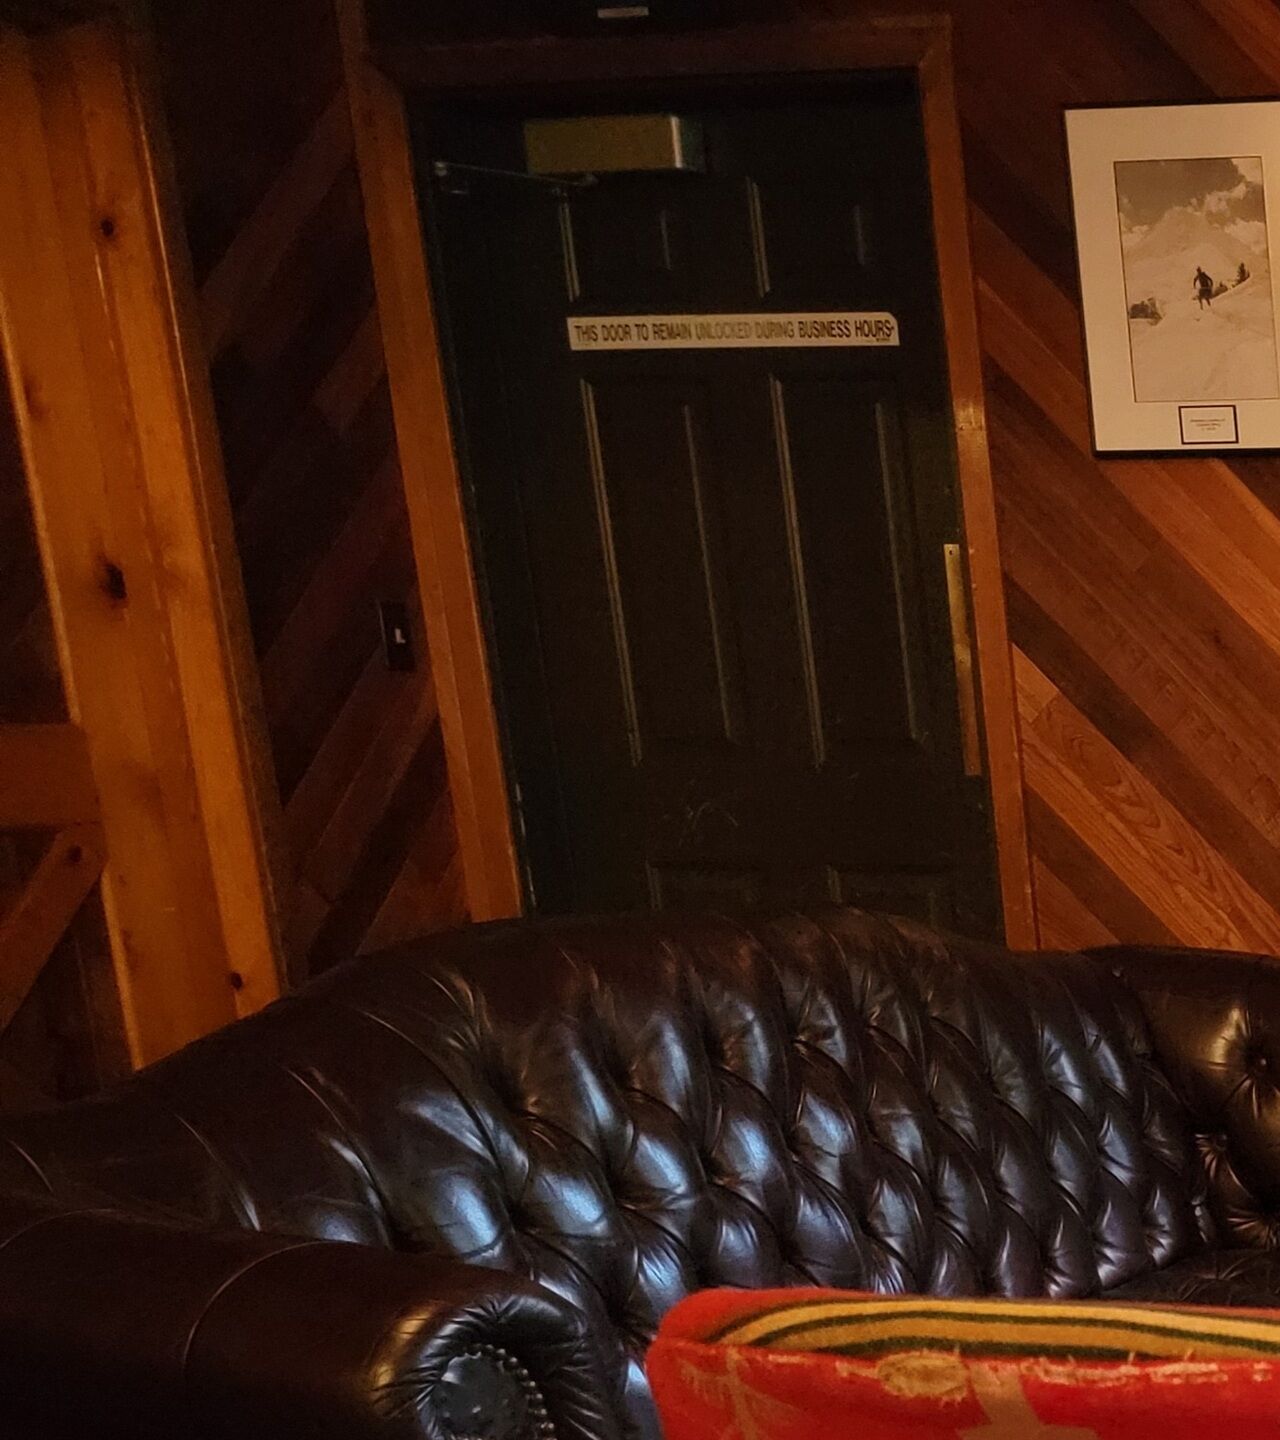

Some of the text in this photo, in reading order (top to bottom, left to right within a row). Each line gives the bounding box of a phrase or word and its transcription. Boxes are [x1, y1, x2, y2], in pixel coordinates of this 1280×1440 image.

[574, 323, 598, 342] THIS
[601, 323, 632, 342] DOOR
[634, 322, 649, 341] TO
[652, 322, 692, 341] REMAIN
[695, 321, 750, 340] UNLOCKED
[755, 320, 795, 340] DURING
[798, 319, 851, 339] BUSINESS
